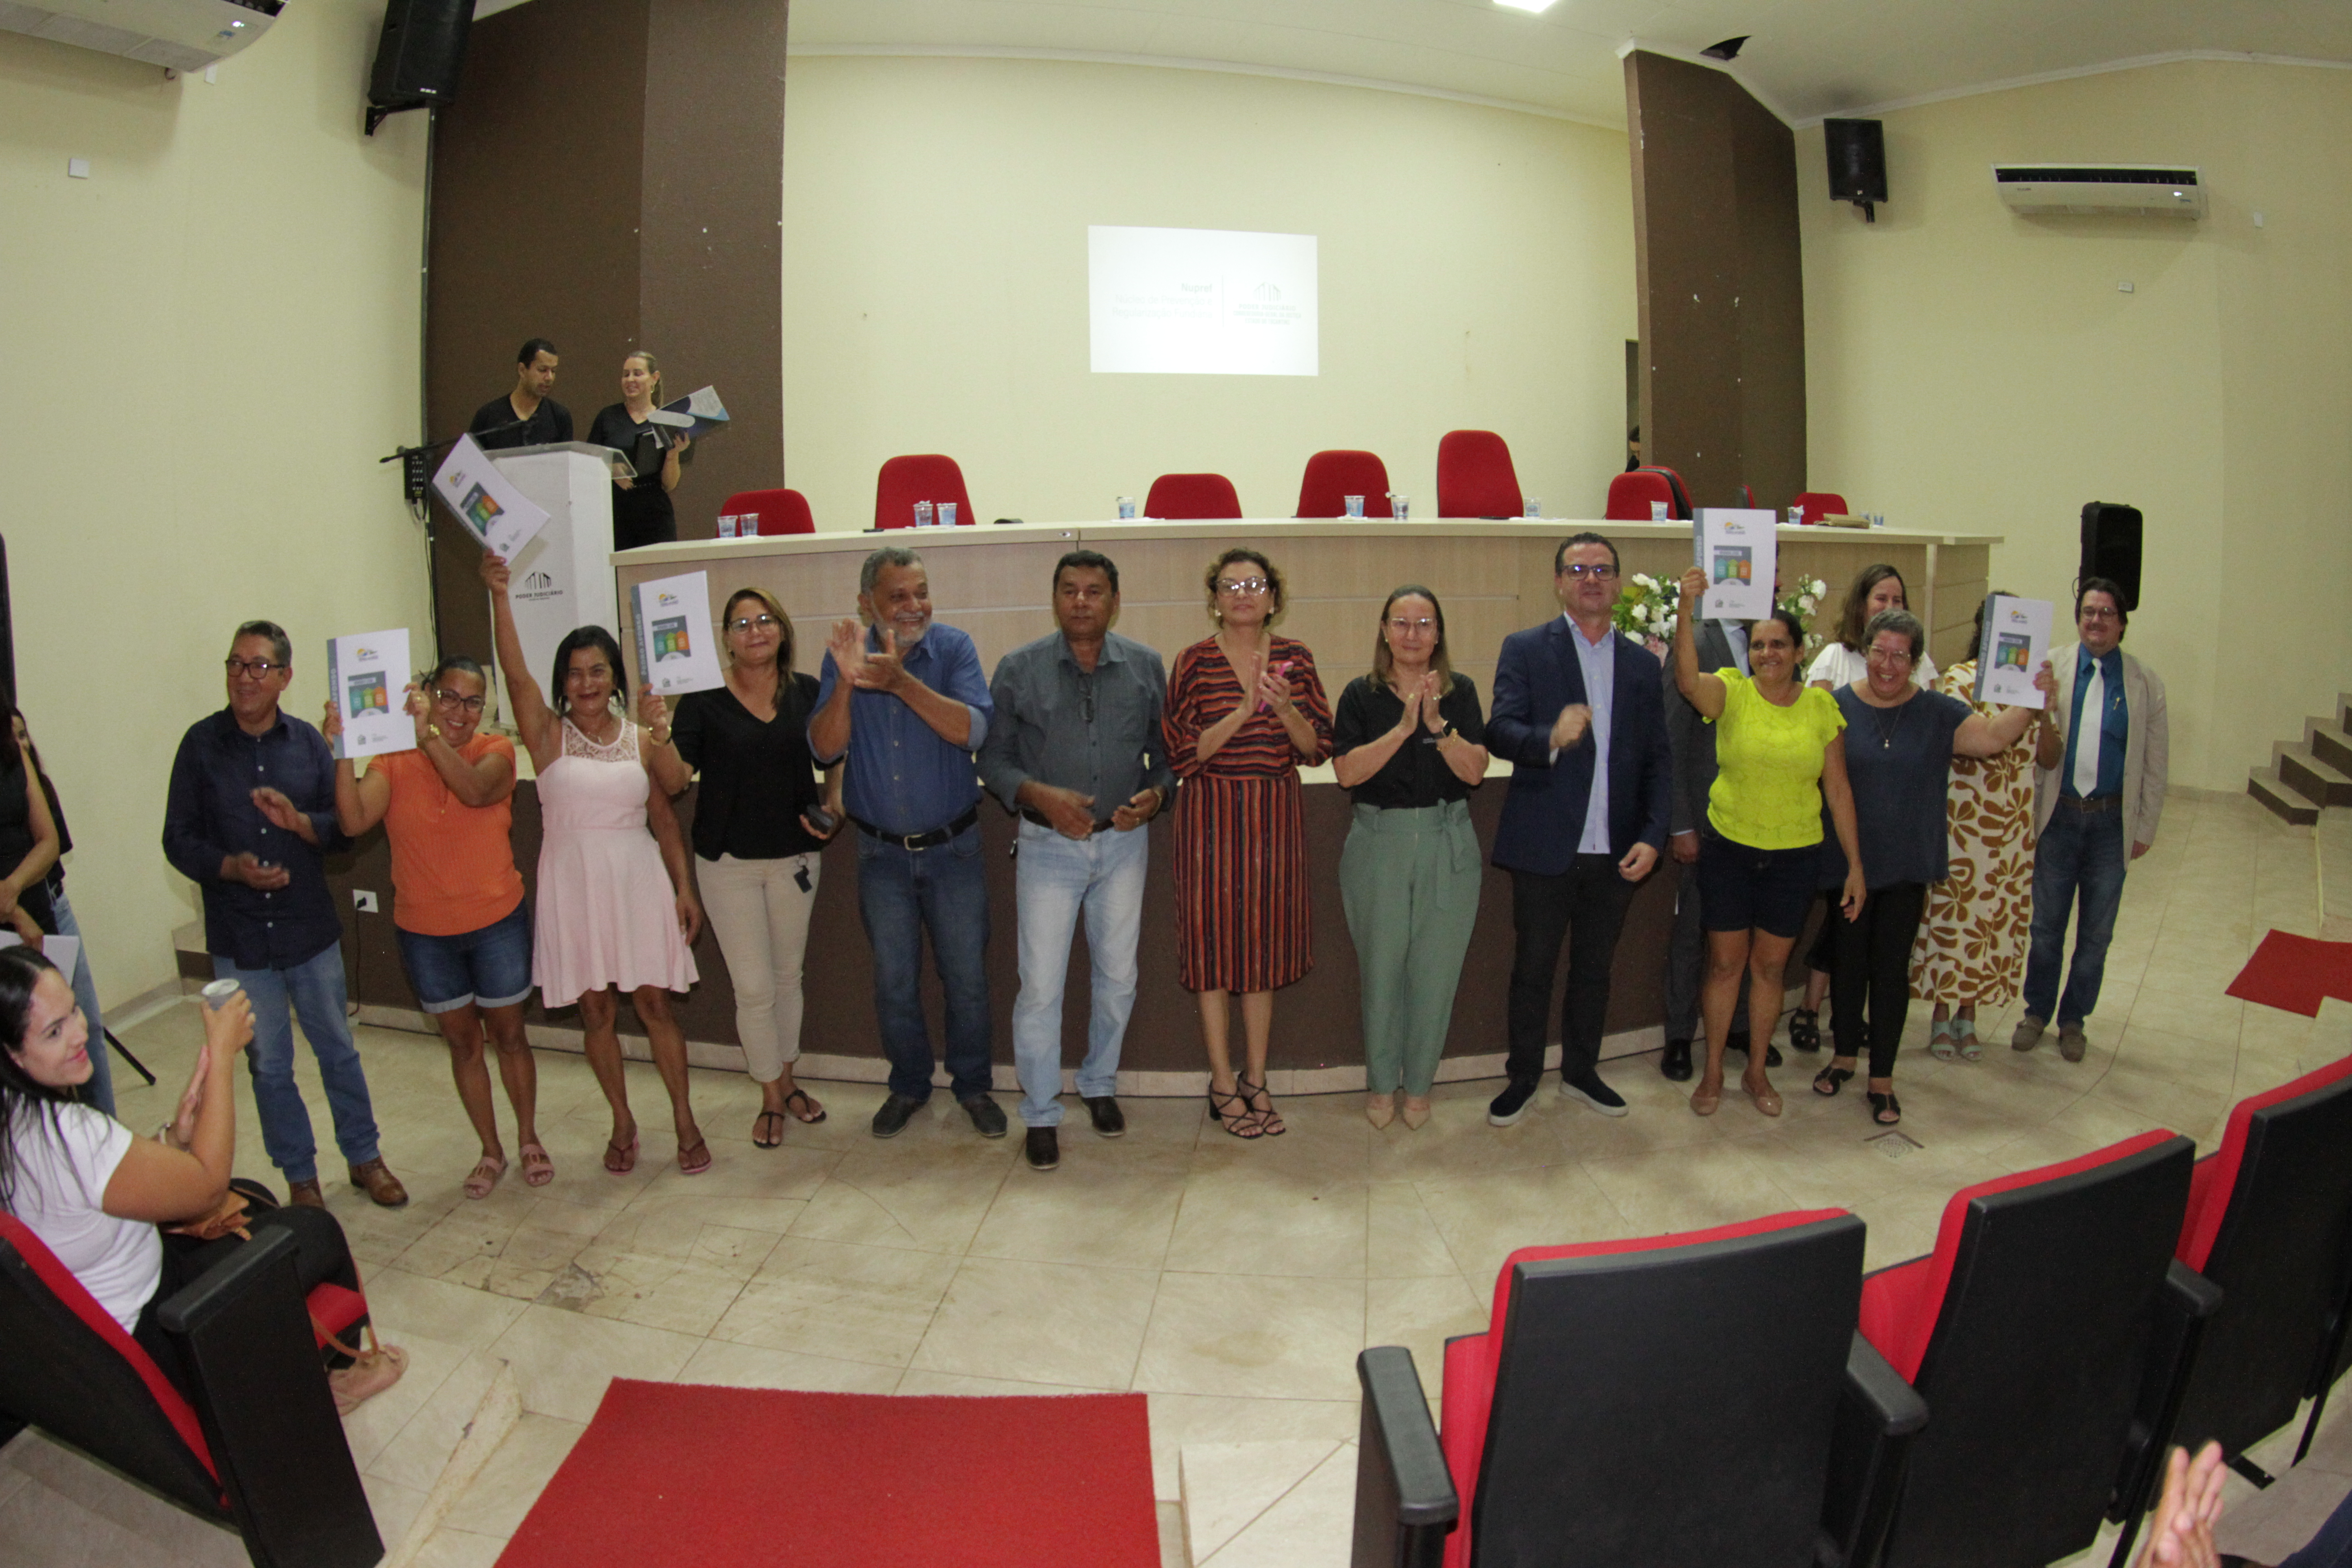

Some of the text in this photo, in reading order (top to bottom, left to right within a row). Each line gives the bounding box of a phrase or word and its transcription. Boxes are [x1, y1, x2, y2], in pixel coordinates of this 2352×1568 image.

[1181, 283, 1213, 294] Nupref
[1115, 294, 1146, 304] Núcleo
[1147, 295, 1159, 304] de
[1161, 295, 1205, 308] Prevenção
[1112, 307, 1213, 320] Regularização Fundiária
[1261, 304, 1296, 312] JUDICIÁRIO
